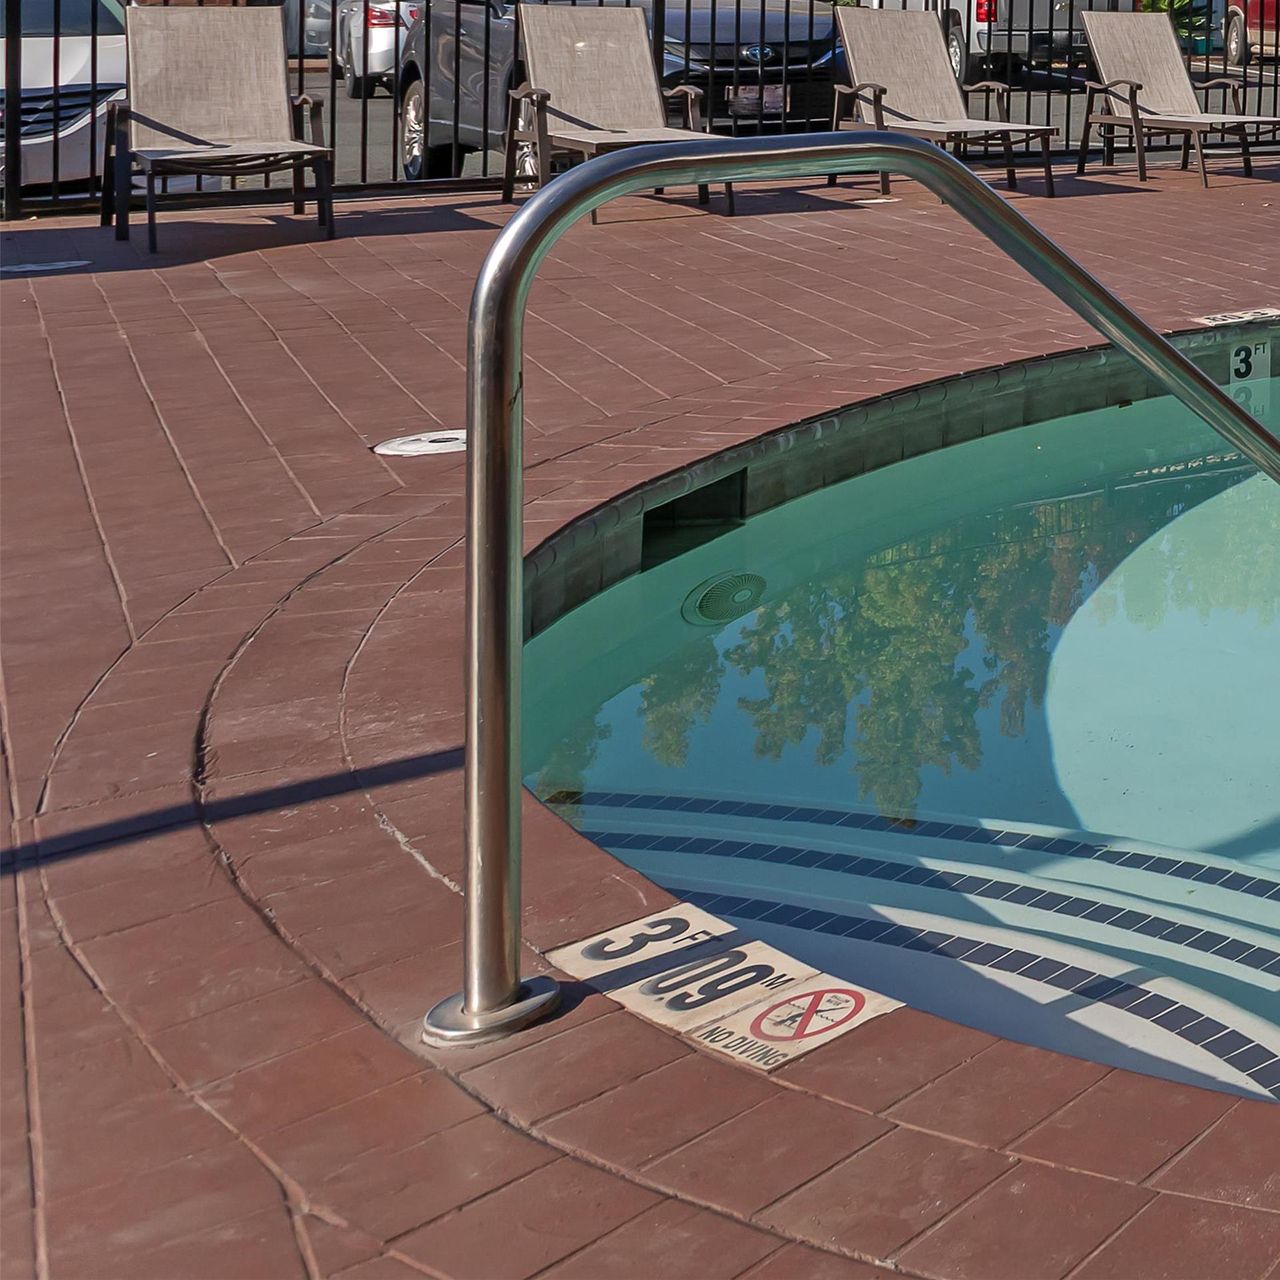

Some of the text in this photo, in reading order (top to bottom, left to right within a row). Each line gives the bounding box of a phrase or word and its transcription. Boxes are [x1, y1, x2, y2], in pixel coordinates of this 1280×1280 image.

[1233, 342, 1267, 379] 3 FT
[580, 917, 724, 961] 3 FT
[639, 950, 795, 1011] 0.9 M
[697, 1026, 789, 1066] NO DIVING
